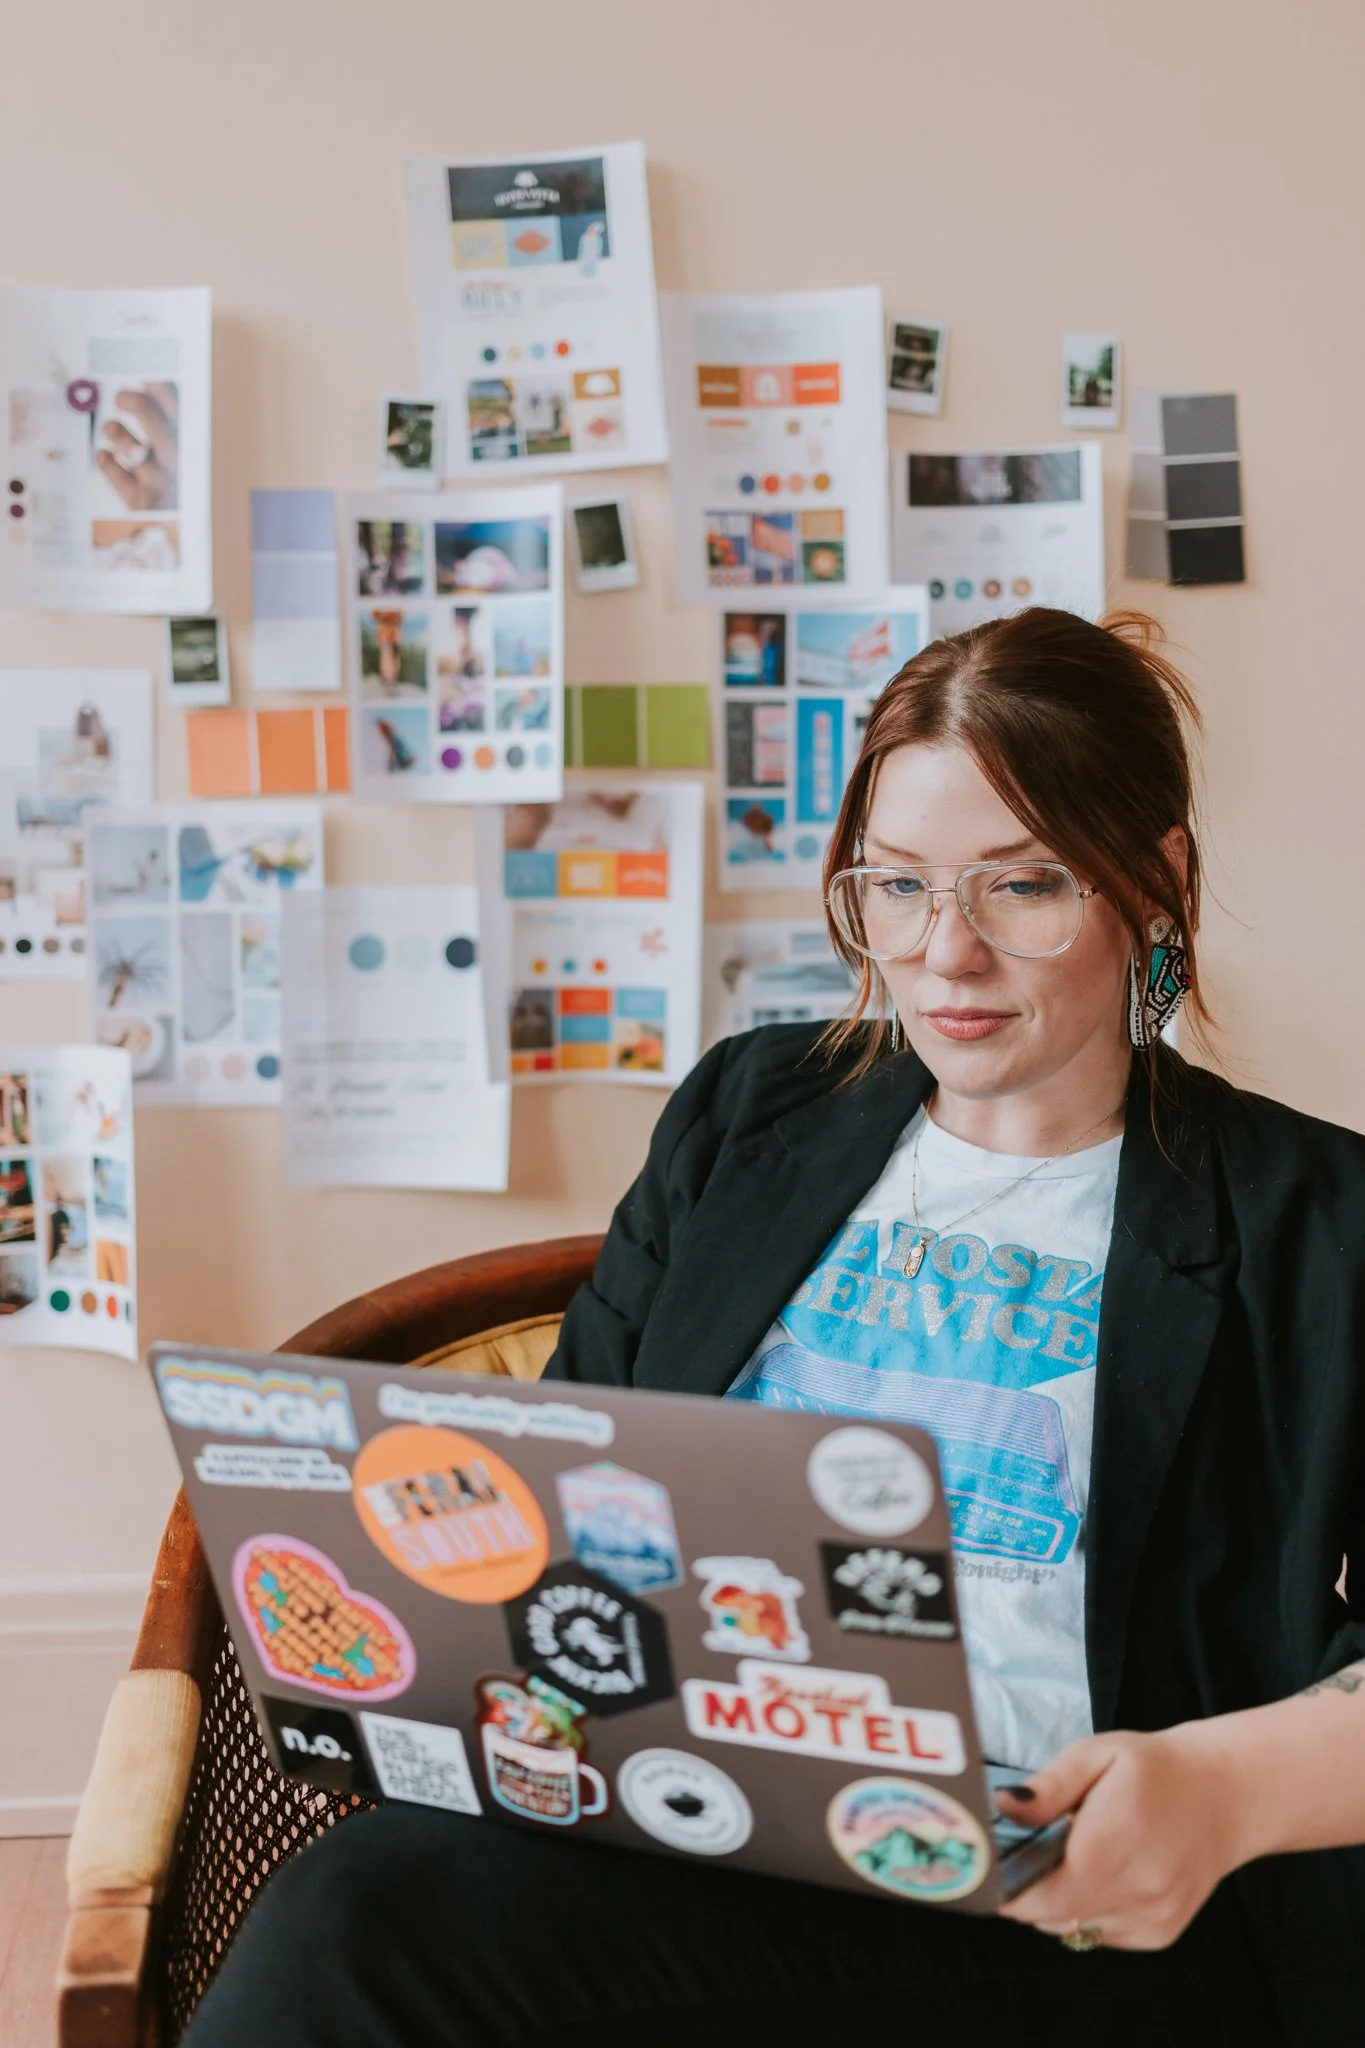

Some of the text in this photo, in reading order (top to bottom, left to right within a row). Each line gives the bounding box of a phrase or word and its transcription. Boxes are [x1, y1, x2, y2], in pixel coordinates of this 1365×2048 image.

[161, 1368, 358, 1451] SSDGM
[391, 1505, 538, 1571] SOUTH
[967, 1503, 983, 1514] 100
[986, 1510, 1003, 1522] 104
[280, 1724, 354, 1762] n.o.
[703, 1691, 945, 1761] MOTEL
